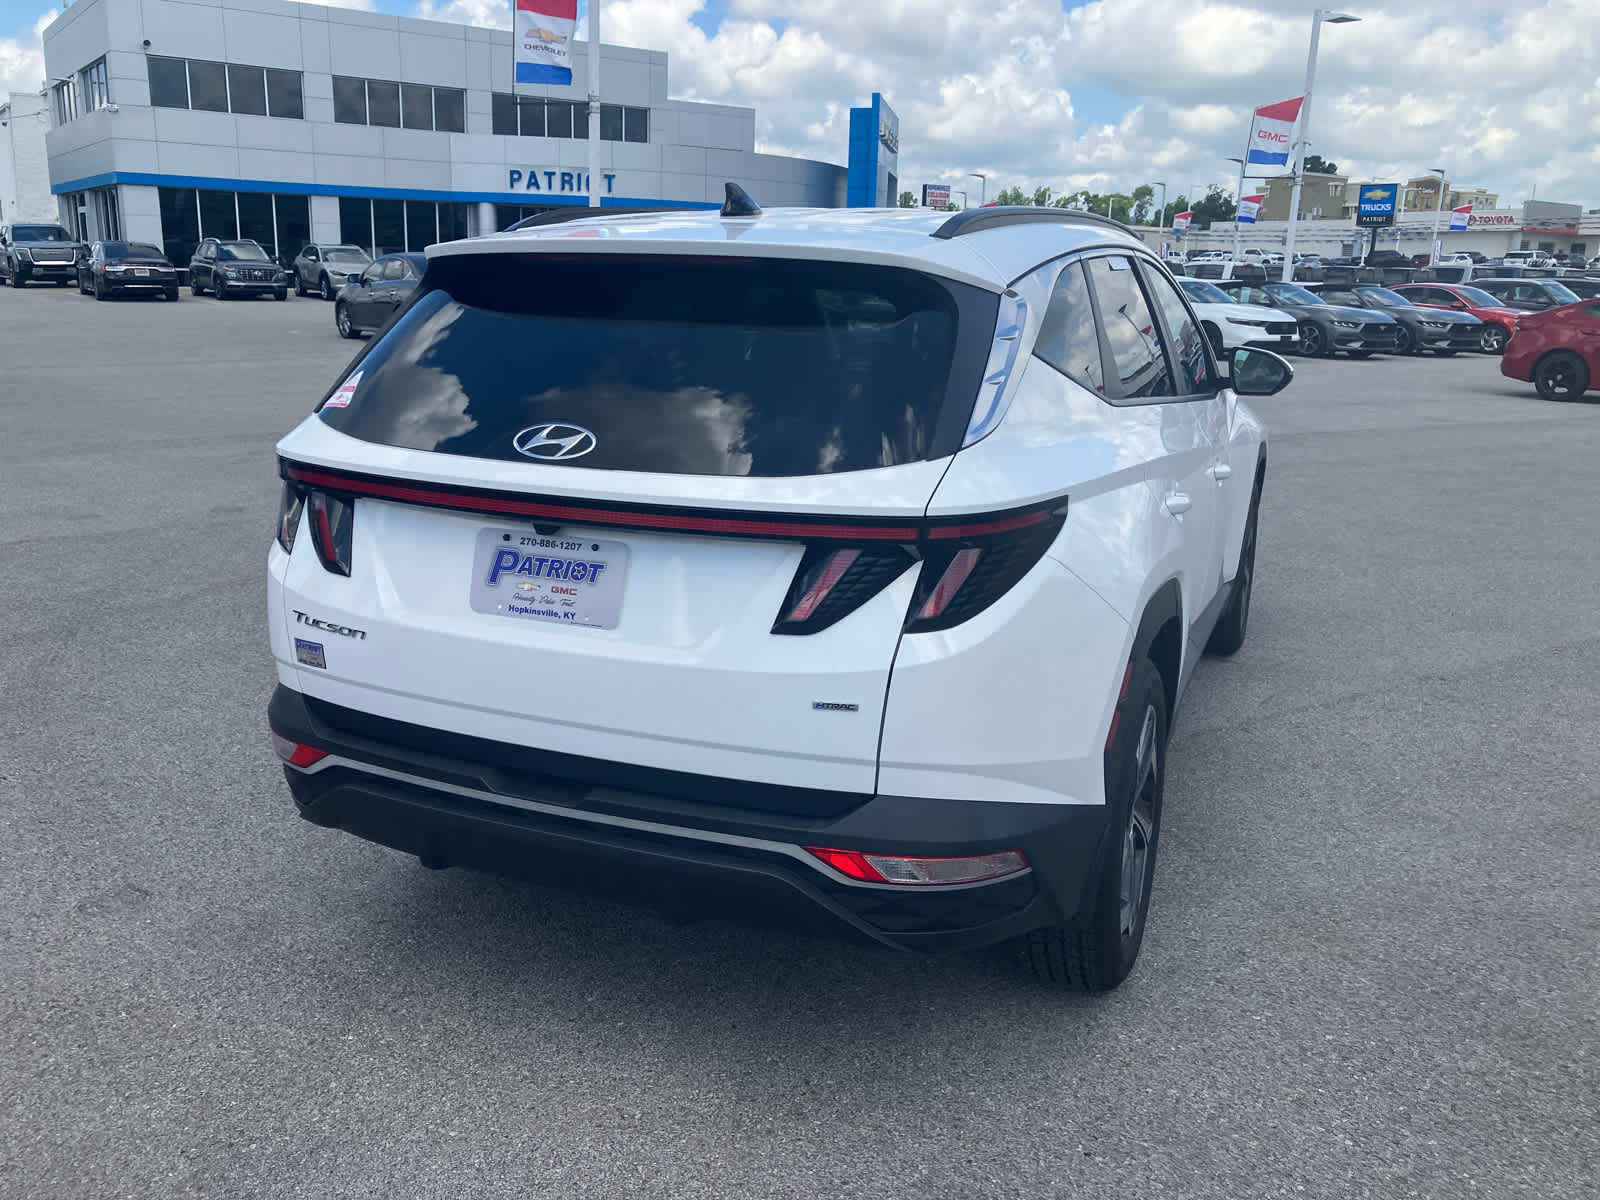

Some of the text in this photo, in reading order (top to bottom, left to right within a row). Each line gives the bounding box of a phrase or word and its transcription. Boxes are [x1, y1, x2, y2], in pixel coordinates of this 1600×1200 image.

[1257, 129, 1289, 143] GMC
[1361, 203, 1392, 211] TRUCKS
[1478, 215, 1514, 224] TOYOTA
[519, 537, 582, 551] 270-886-1207
[487, 548, 607, 585] PATRIOT
[551, 585, 577, 596] GMC
[508, 604, 576, 620] Hopkinsville, KY
[812, 702, 859, 712] HTRAC
